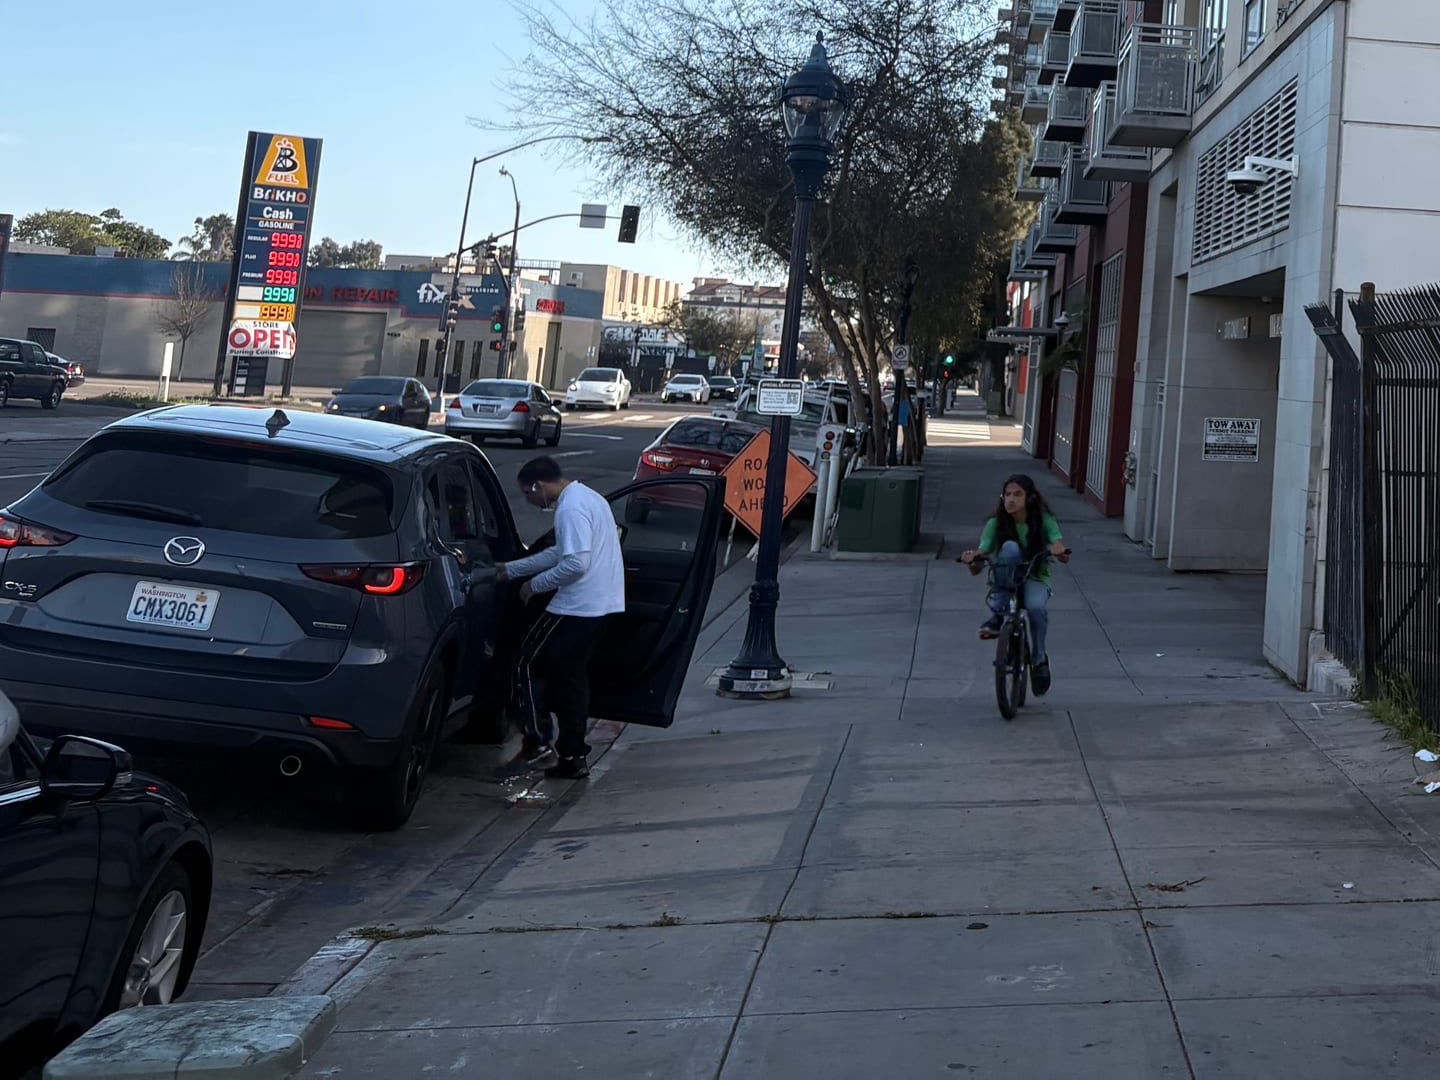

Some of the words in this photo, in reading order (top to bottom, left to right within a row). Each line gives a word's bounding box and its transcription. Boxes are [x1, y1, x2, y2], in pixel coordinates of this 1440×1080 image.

[267, 173, 299, 184] FUEL
[263, 206, 293, 220] Cash
[258, 220, 295, 230] GASOLINE
[332, 287, 399, 302] REPAIR
[229, 328, 296, 350] OPEN
[1208, 420, 1228, 429] TOW
[1230, 421, 1257, 430] AWAY
[744, 458, 768, 471] RO
[743, 477, 766, 490] WO
[738, 496, 789, 511] AHD
[4, 581, 37, 592] CX-5
[141, 588, 187, 600] WASHINGTON
[133, 596, 207, 623] CMX3061
